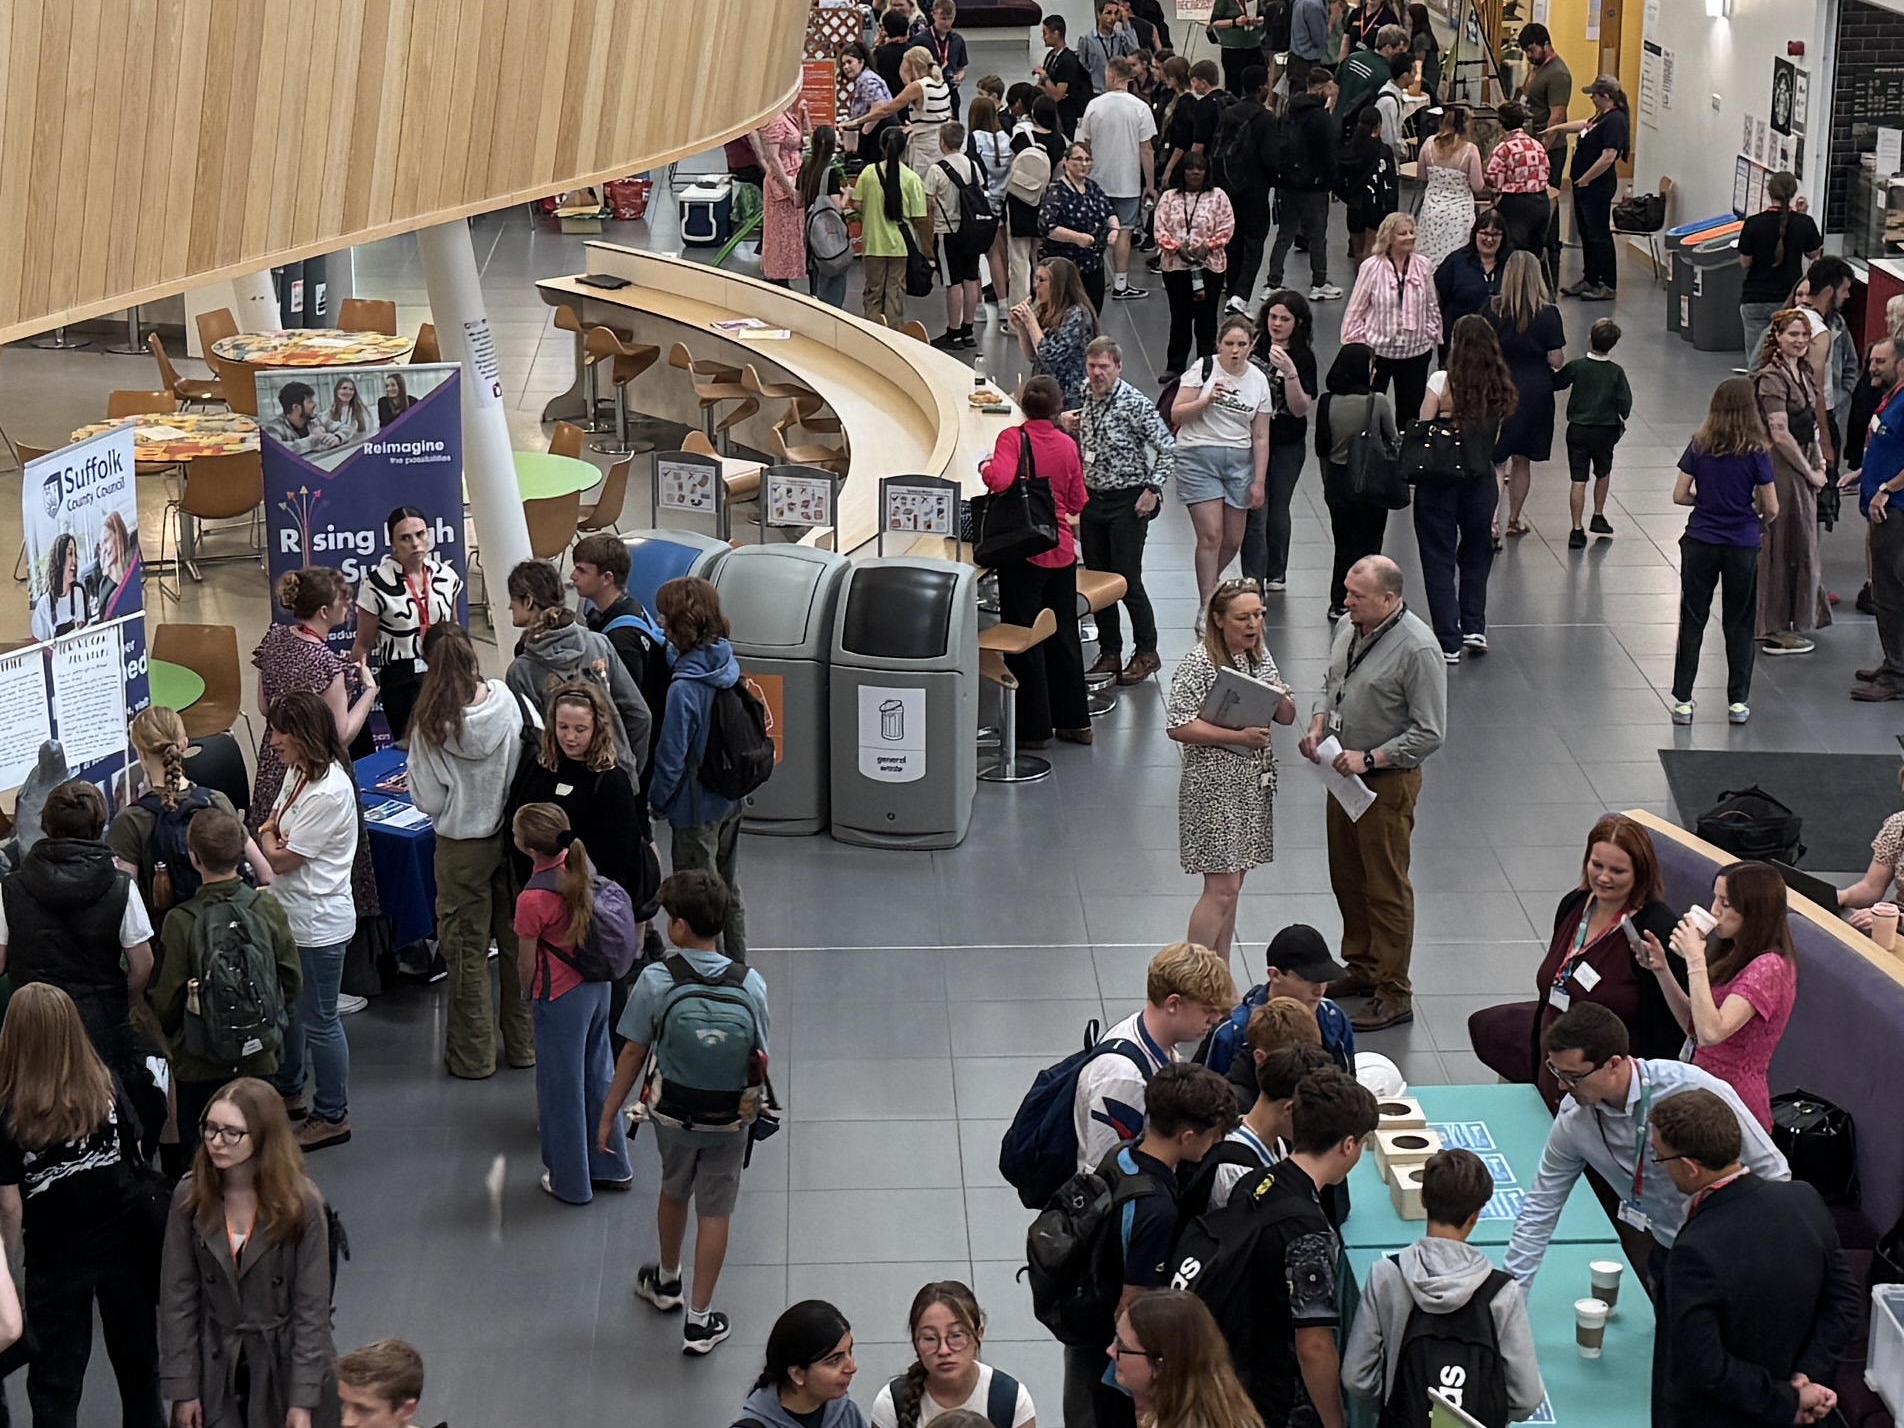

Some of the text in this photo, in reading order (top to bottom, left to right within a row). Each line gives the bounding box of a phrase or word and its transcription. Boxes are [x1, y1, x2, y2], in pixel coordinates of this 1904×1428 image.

[364, 440, 444, 456] Reimagine
[65, 449, 123, 494] Suffolk
[67, 476, 125, 512] County Council
